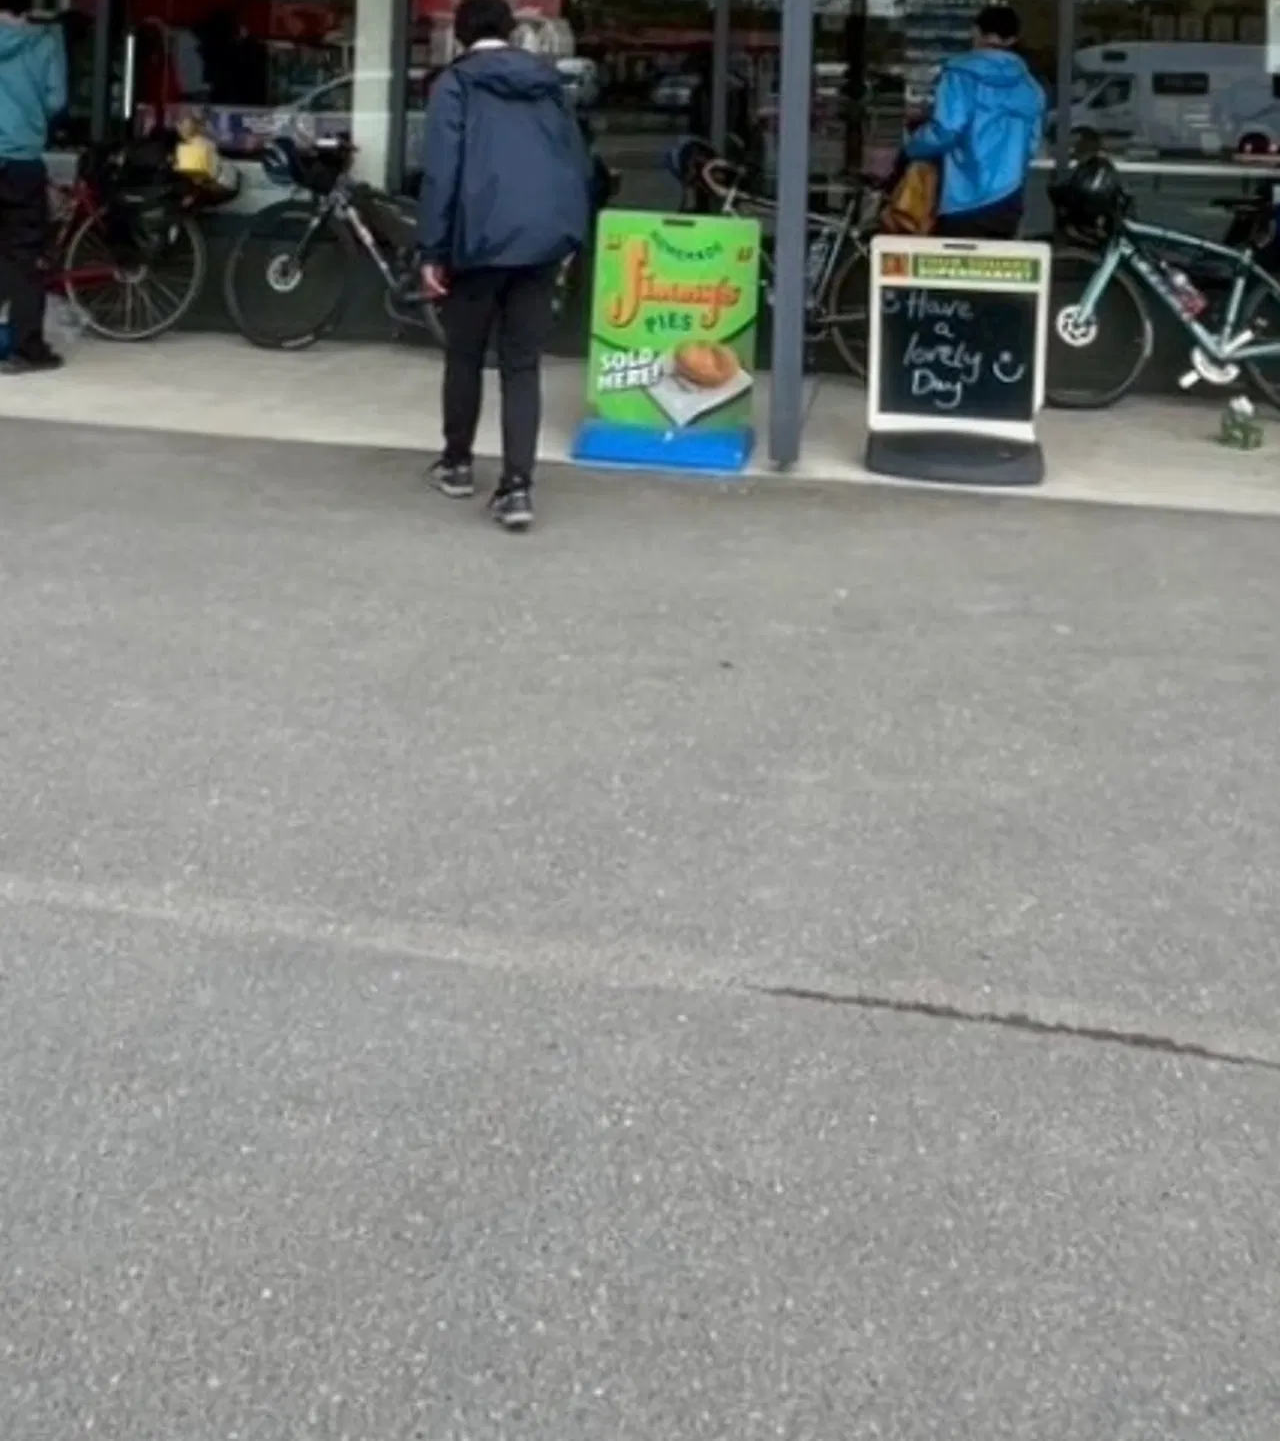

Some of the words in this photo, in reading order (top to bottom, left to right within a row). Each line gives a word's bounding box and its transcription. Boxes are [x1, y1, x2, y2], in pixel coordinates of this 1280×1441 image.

[907, 289, 974, 320] Have
[644, 311, 693, 334] PIES
[600, 347, 657, 371] SOLD
[911, 367, 963, 409] Day
